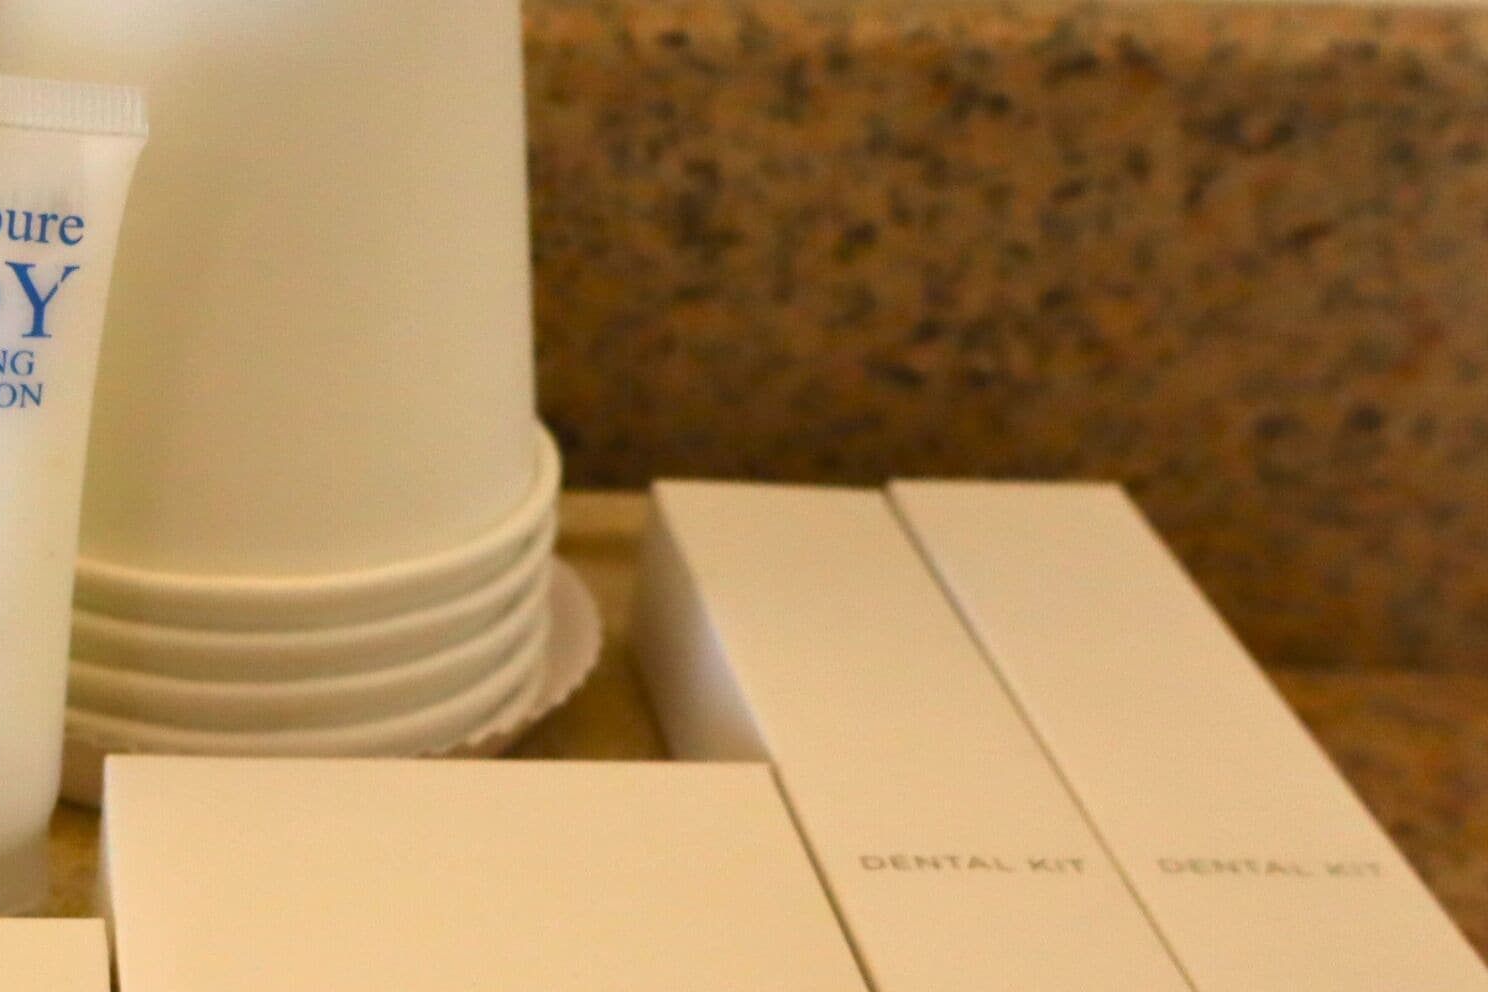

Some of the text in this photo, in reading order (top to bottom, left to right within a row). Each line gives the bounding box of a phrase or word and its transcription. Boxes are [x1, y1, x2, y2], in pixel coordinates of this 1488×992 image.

[859, 854, 1084, 874] DENTAL KIT
[1157, 858, 1382, 877] DENTAL KIT
